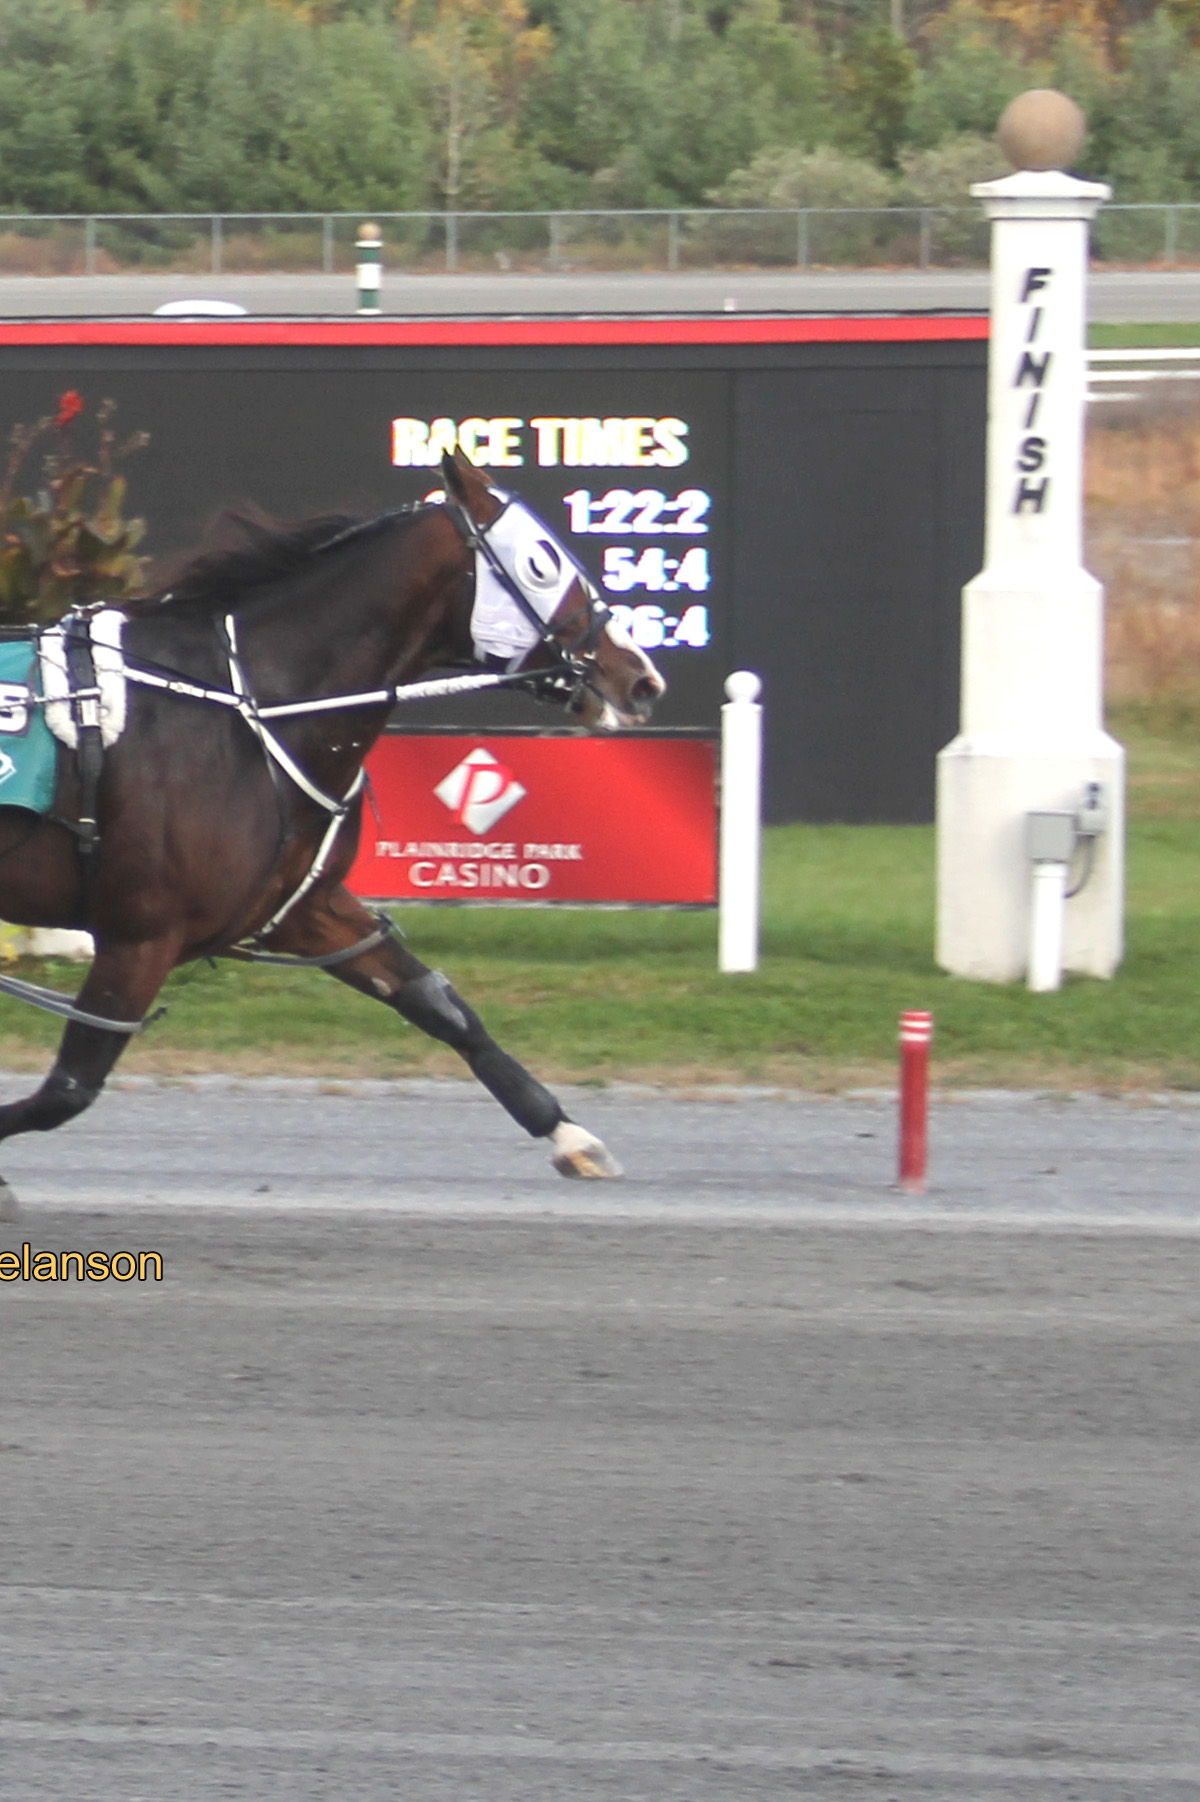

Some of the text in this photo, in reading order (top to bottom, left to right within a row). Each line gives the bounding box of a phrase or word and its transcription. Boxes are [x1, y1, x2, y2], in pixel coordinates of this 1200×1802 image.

[1014, 267, 1053, 514] FINISH
[391, 418, 689, 467] RACE TIMES
[563, 489, 711, 533] 1:22:2
[602, 547, 711, 591] 54:4
[375, 842, 583, 860] PLAINRIDGE PARK
[408, 862, 550, 889] CASINO
